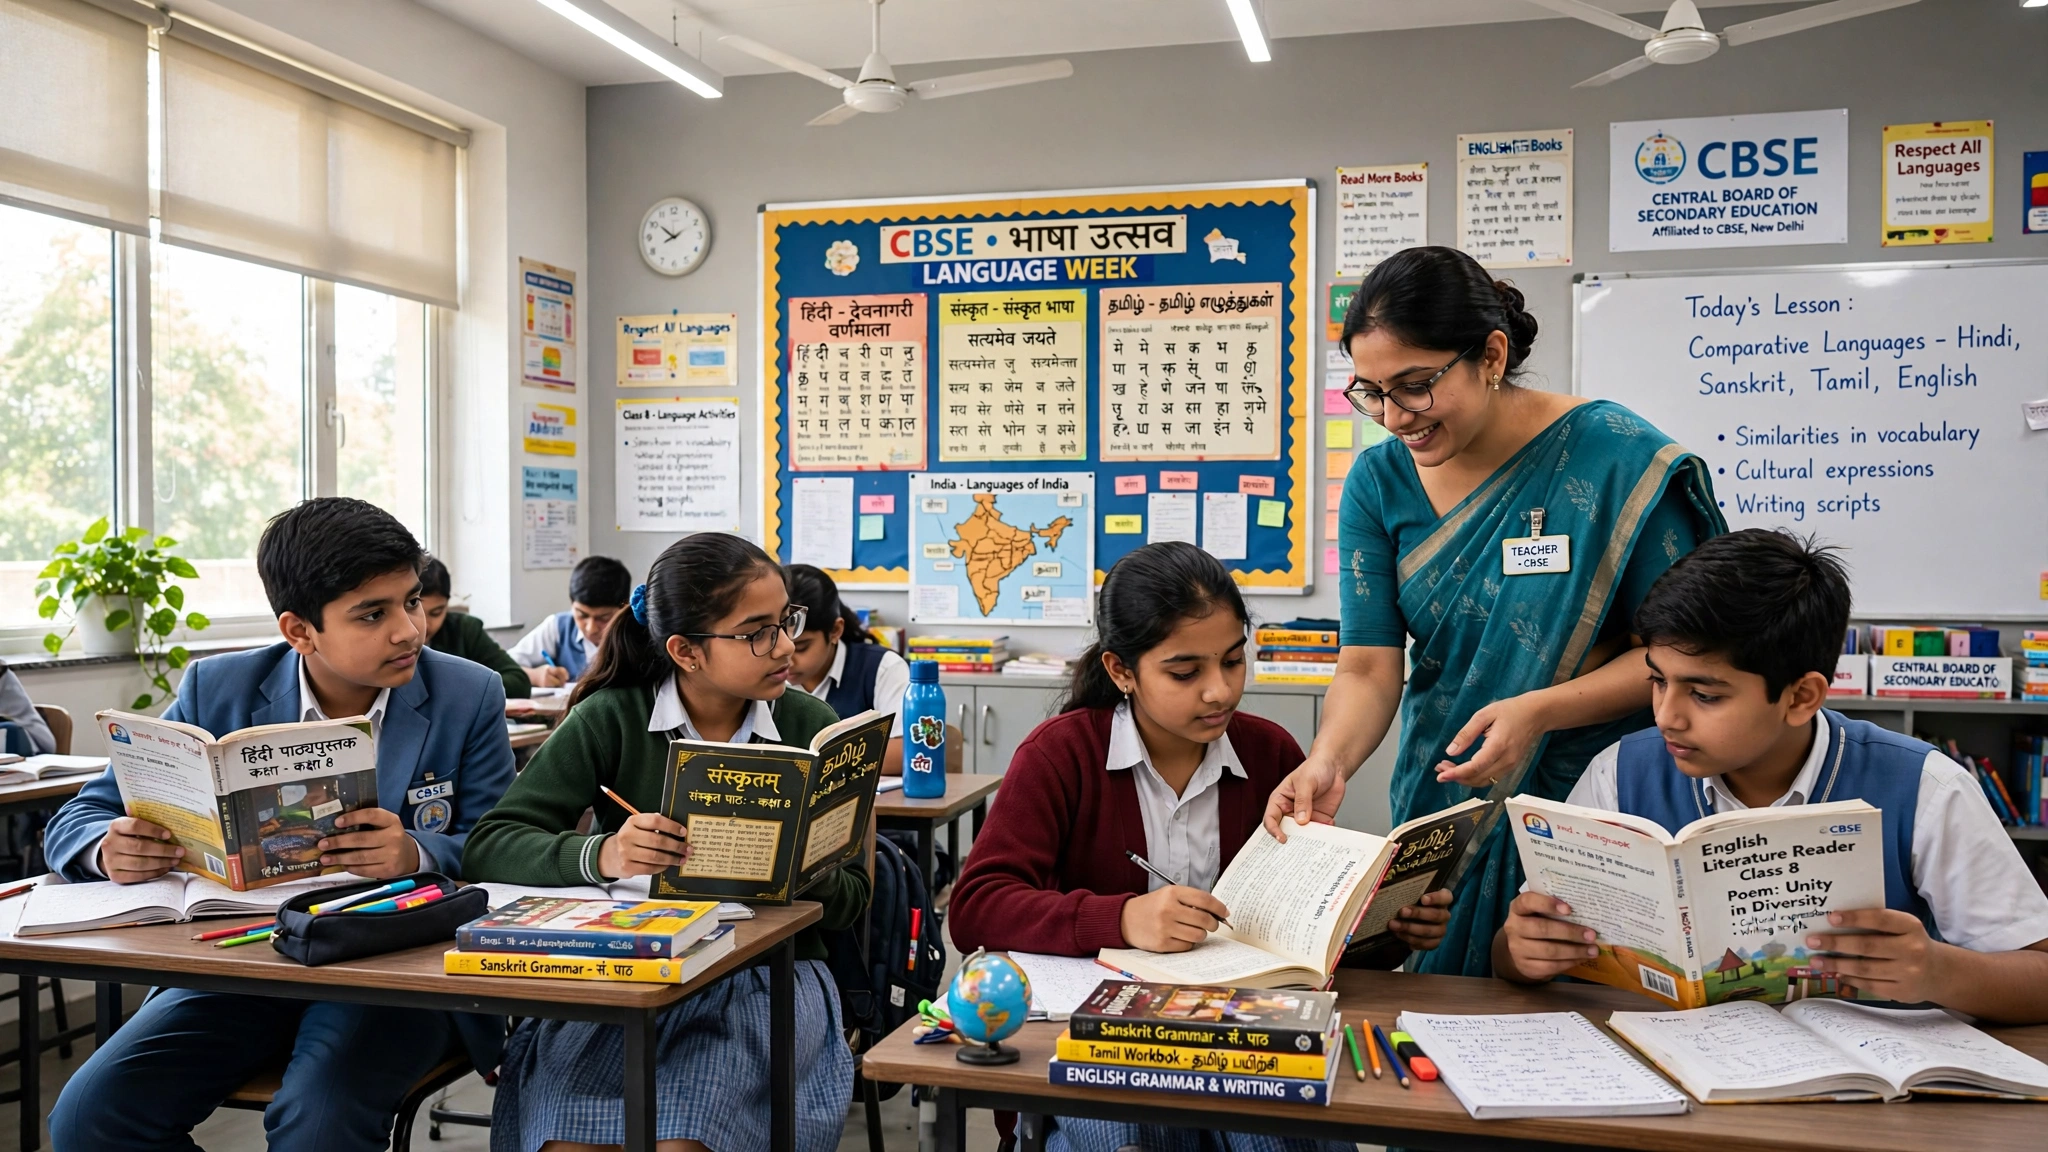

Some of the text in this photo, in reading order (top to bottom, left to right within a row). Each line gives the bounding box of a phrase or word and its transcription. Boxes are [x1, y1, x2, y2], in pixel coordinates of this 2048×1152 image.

[1531, 138, 1562, 152] Books
[1895, 140, 1981, 159] Respect All
[1697, 137, 1818, 179] CBSE
[1341, 171, 1423, 185] Read More Books
[1898, 161, 1980, 177] Languages
[1653, 187, 1798, 205] CENTRAL BOARD OF
[670, 206, 678, 215] 12
[1638, 202, 1818, 223] SECONDARY EDUCATION
[890, 221, 1176, 257] CBSE भाषा उत्सव
[1653, 220, 1804, 237] Affiliated to CBSE, New Delhi
[660, 257, 664, 265] 7
[923, 257, 1138, 285] LANGUAGE WEEK
[801, 298, 913, 322] हिंदी देवनागरी
[950, 298, 1075, 321] संस्कृत संस्कृत भाषा
[1108, 290, 1273, 315] தமிழ் தமிழ் எழுத்துகள்
[1685, 293, 1840, 326] Today's Lesson
[623, 324, 658, 337] Respect
[680, 323, 730, 335] Languages
[829, 319, 891, 338] वर्णमाला
[967, 327, 1057, 346] सत्यमेव जयते
[1689, 323, 2021, 364] Comparative Languages Hindi,
[1700, 363, 1977, 397] Sanskrit, Tamil, English
[623, 410, 642, 419] Class
[658, 409, 696, 422] Language
[699, 409, 735, 419] Activities
[1736, 421, 1980, 450] Similarities in vocabulary
[1736, 458, 1934, 485] Cultural expressions
[931, 478, 1069, 492] India Languages of India
[1736, 493, 1881, 521] Writing scripts
[1511, 545, 1558, 556] TEACHER
[1892, 662, 1996, 674] CENTRAL BOARD OF
[1884, 675, 1946, 687] SECONDARY
[240, 736, 358, 765] हिंदी पाठ्यपुस्तक
[820, 737, 867, 783] தமிழ்
[249, 757, 334, 779] कक्षा कक्षा 8
[707, 763, 781, 794] संस्कृतम्
[416, 784, 446, 799] CBSE
[688, 789, 721, 807] संस्कृत
[784, 799, 791, 808] 8
[1829, 823, 1862, 833] CBSE
[1399, 824, 1455, 862] தமிழ்
[1702, 833, 1768, 857] English
[1703, 840, 1856, 873] Literature Reader
[1740, 862, 1800, 881] Class 8
[1728, 879, 1833, 902] Poem: Unity
[1731, 895, 1828, 916] in Diversity
[1740, 913, 1776, 927] Cultural
[480, 959, 634, 976] Sanskrit Grammar सं. पाठ
[1100, 1022, 1269, 1047] Sanskrit Grammar सं. पाठ
[1089, 1045, 1120, 1060] Tamil
[1191, 1052, 1228, 1071] தமிழ்
[1233, 1055, 1279, 1074] பயிற்சி
[1066, 1067, 1285, 1097] ENGLISH GRAMMAR & WRITING
